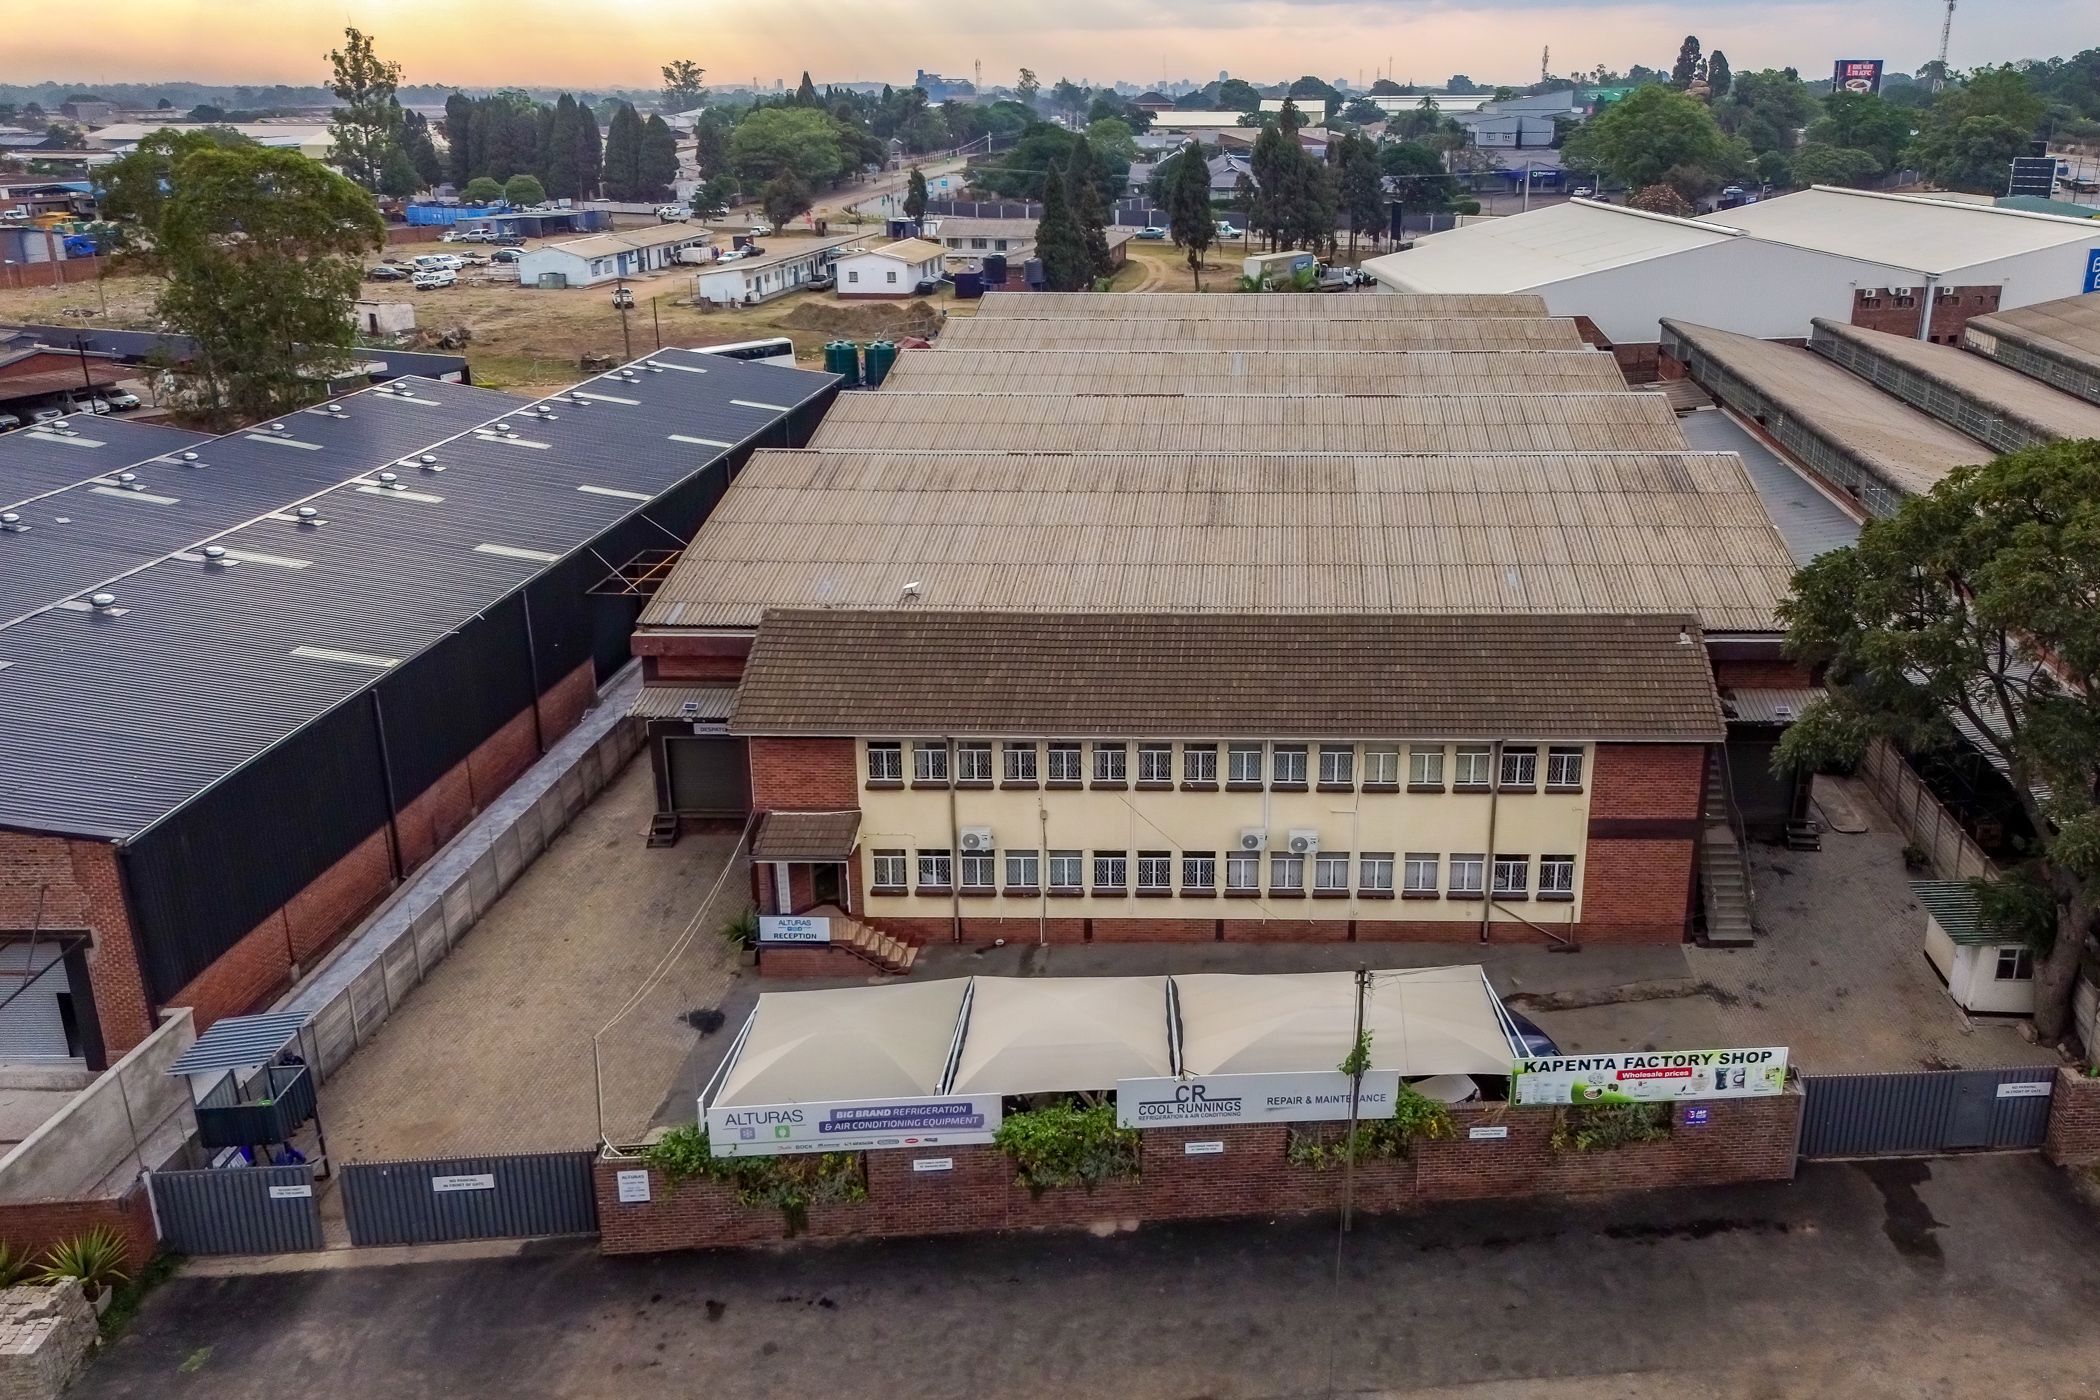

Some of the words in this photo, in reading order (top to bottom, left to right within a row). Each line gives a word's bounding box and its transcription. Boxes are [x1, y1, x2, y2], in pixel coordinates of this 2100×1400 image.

[1523, 1057, 1617, 1073] KAPENTA
[1624, 1053, 1714, 1069] FACTORY
[1718, 1050, 1773, 1065] SHOP
[1622, 1070, 1663, 1079] Wholesale
[1664, 1069, 1690, 1079] prices
[1175, 1084, 1207, 1102] CR
[1266, 1096, 1302, 1106] REPAIR
[1305, 1096, 1313, 1105] &
[1315, 1093, 1386, 1104] MAINTEANCE
[836, 1110, 854, 1119] BIG
[855, 1108, 891, 1118] BRAND
[892, 1104, 967, 1116] REFRIGERATION
[1138, 1103, 1175, 1116] COOL
[1176, 1101, 1242, 1114] RUNNINGS
[1200, 1111, 1242, 1119] CONDITIONING
[725, 1109, 804, 1126] ALTURAS
[824, 1122, 832, 1130] &
[834, 1121, 850, 1130] AIR
[851, 1118, 921, 1129] CONDITIONING
[922, 1115, 979, 1127] EQUIPMENT
